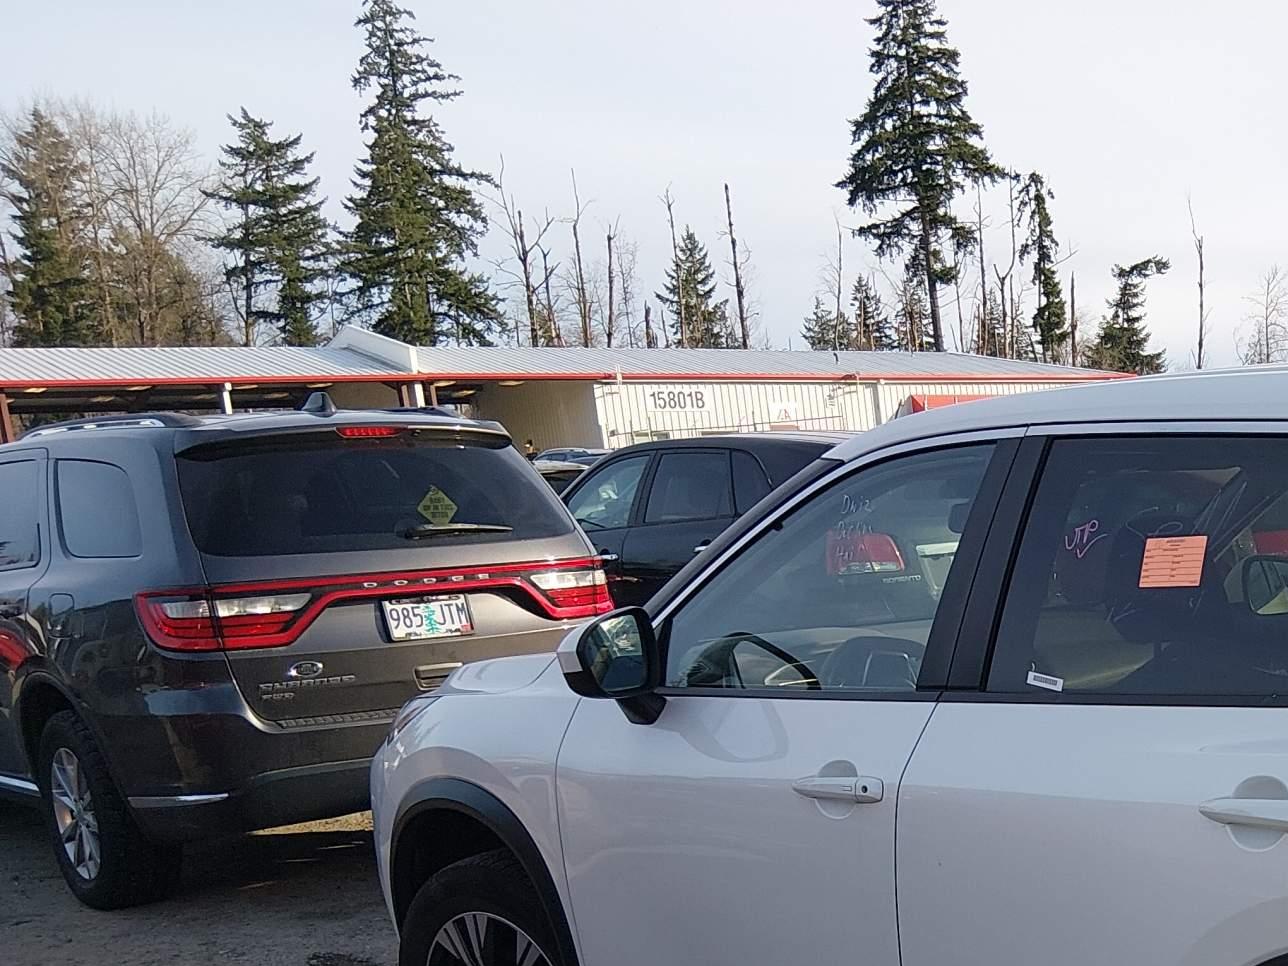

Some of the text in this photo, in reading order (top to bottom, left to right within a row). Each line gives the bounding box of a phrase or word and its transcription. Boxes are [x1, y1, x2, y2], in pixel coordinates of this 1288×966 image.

[649, 390, 705, 410] 15801B
[363, 573, 490, 589] DODGE
[389, 602, 470, 629] 985 JTM
